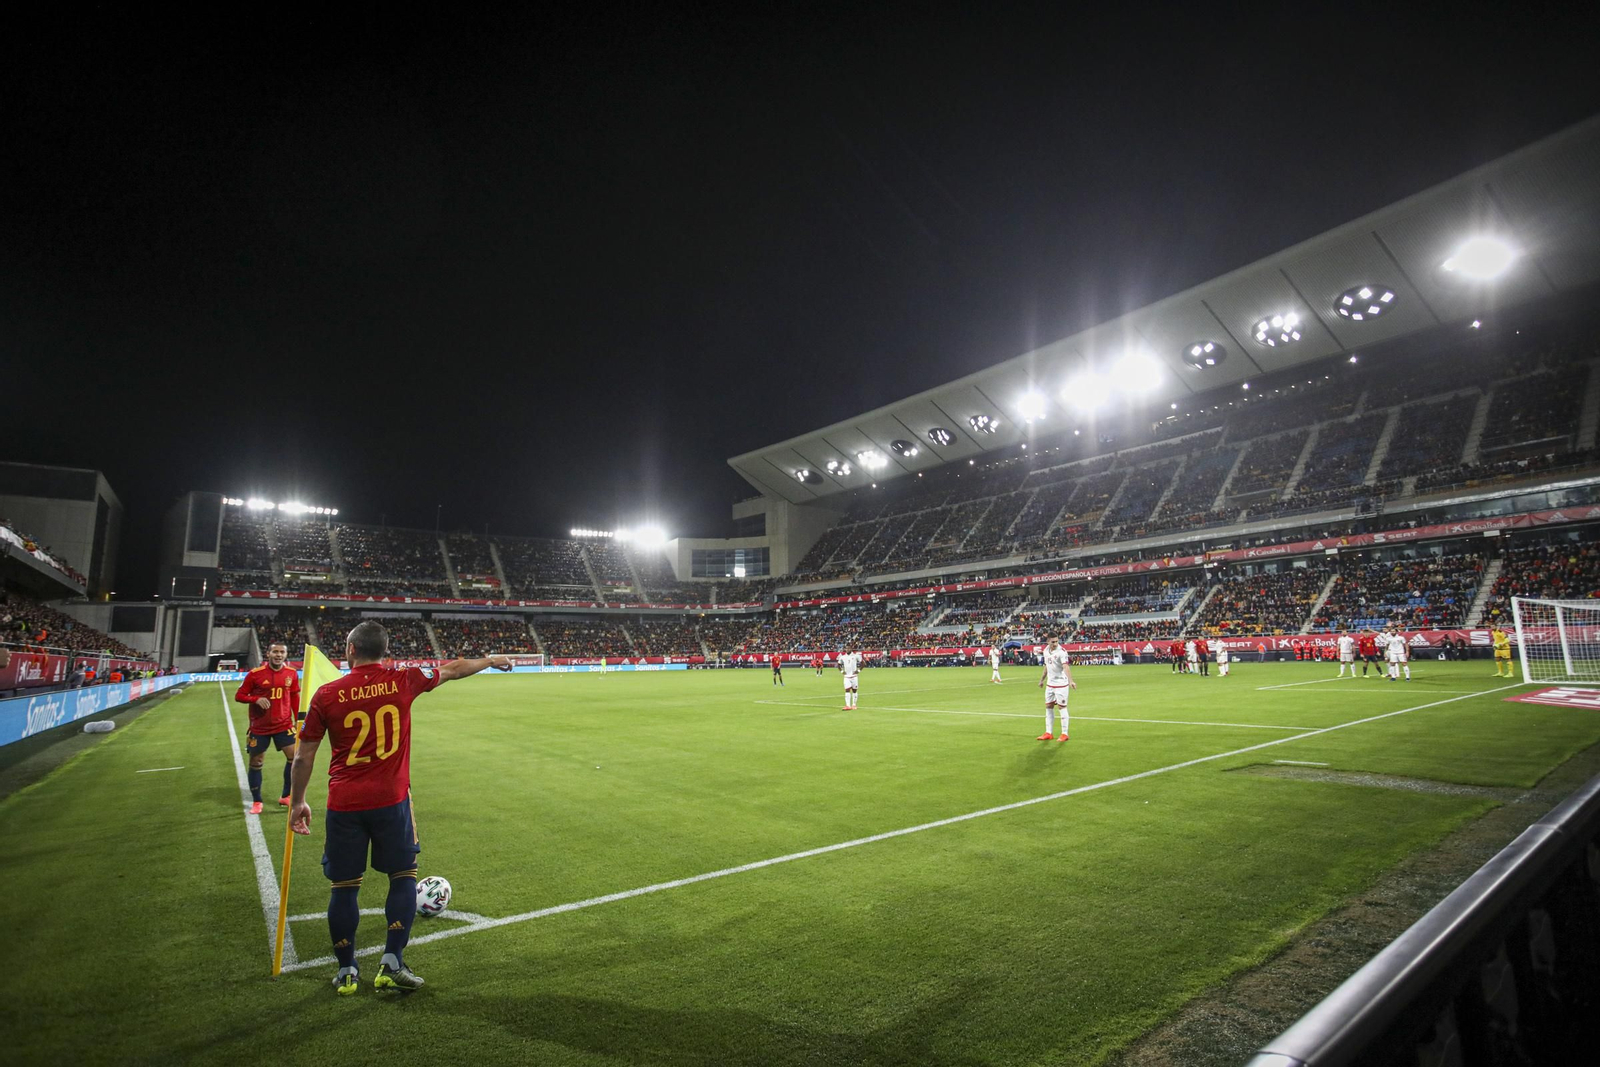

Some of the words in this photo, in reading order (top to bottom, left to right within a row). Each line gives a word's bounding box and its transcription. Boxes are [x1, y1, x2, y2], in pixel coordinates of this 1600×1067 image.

[1463, 521, 1507, 533] CaixaBank
[1388, 531, 1418, 539] SEAT
[1256, 546, 1286, 556] CaixaBank
[1031, 574, 1062, 583] SELECCIÓN
[1062, 570, 1091, 580] ESPAÑOLA
[1100, 566, 1122, 576] FÚTBOL
[635, 663, 659, 671] Sanitas
[189, 673, 233, 682] Sanitas
[270, 687, 283, 700] 10
[338, 689, 349, 704] S.
[351, 680, 399, 702] CAZORLA
[22, 694, 60, 739] Sanitas
[343, 704, 400, 766] 20
